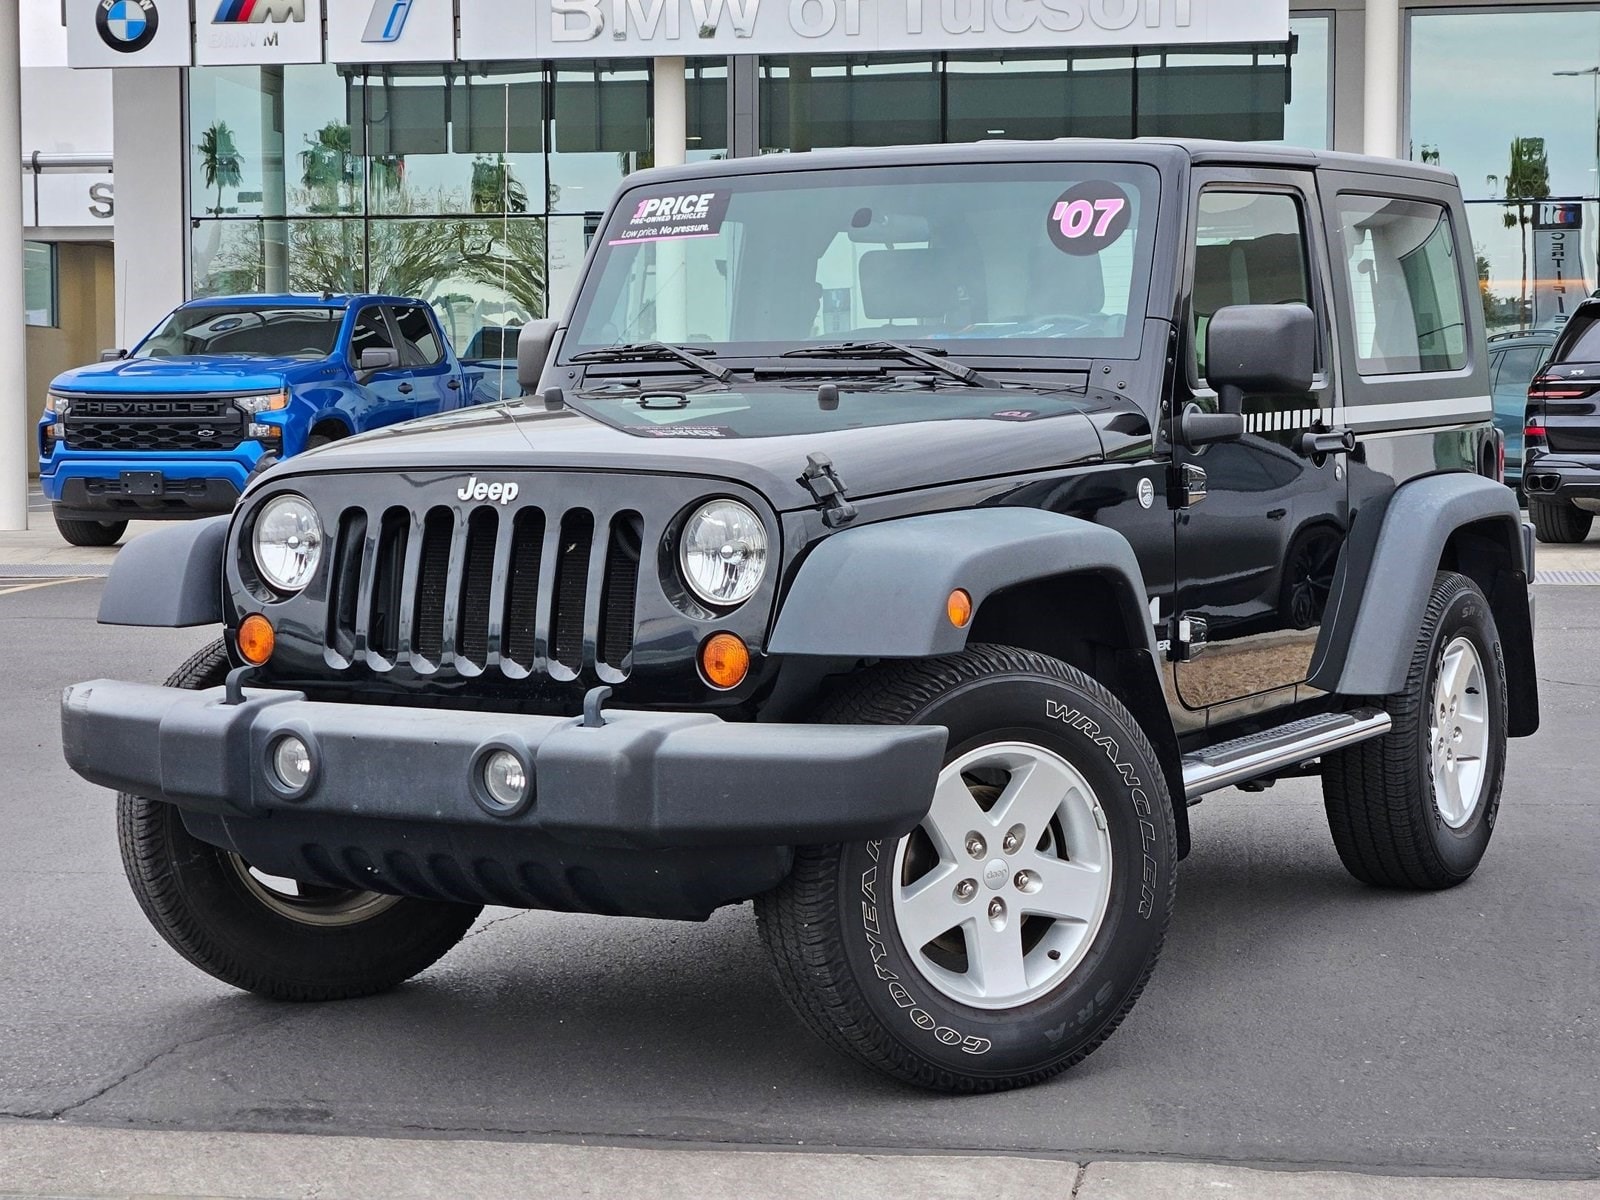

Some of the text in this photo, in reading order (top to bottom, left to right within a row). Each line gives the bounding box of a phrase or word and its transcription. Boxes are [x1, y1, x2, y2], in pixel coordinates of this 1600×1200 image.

[551, 0, 760, 42] BMW
[208, 31, 279, 49] BMW M
[630, 211, 707, 225] PRE-OWNED VEHICLES
[1052, 198, 1125, 239] '07
[621, 230, 637, 239] Low
[659, 225, 673, 235] No
[73, 402, 226, 414] CHEVROLET
[457, 476, 519, 505] Jeep
[1046, 699, 1157, 920] WRANGLER
